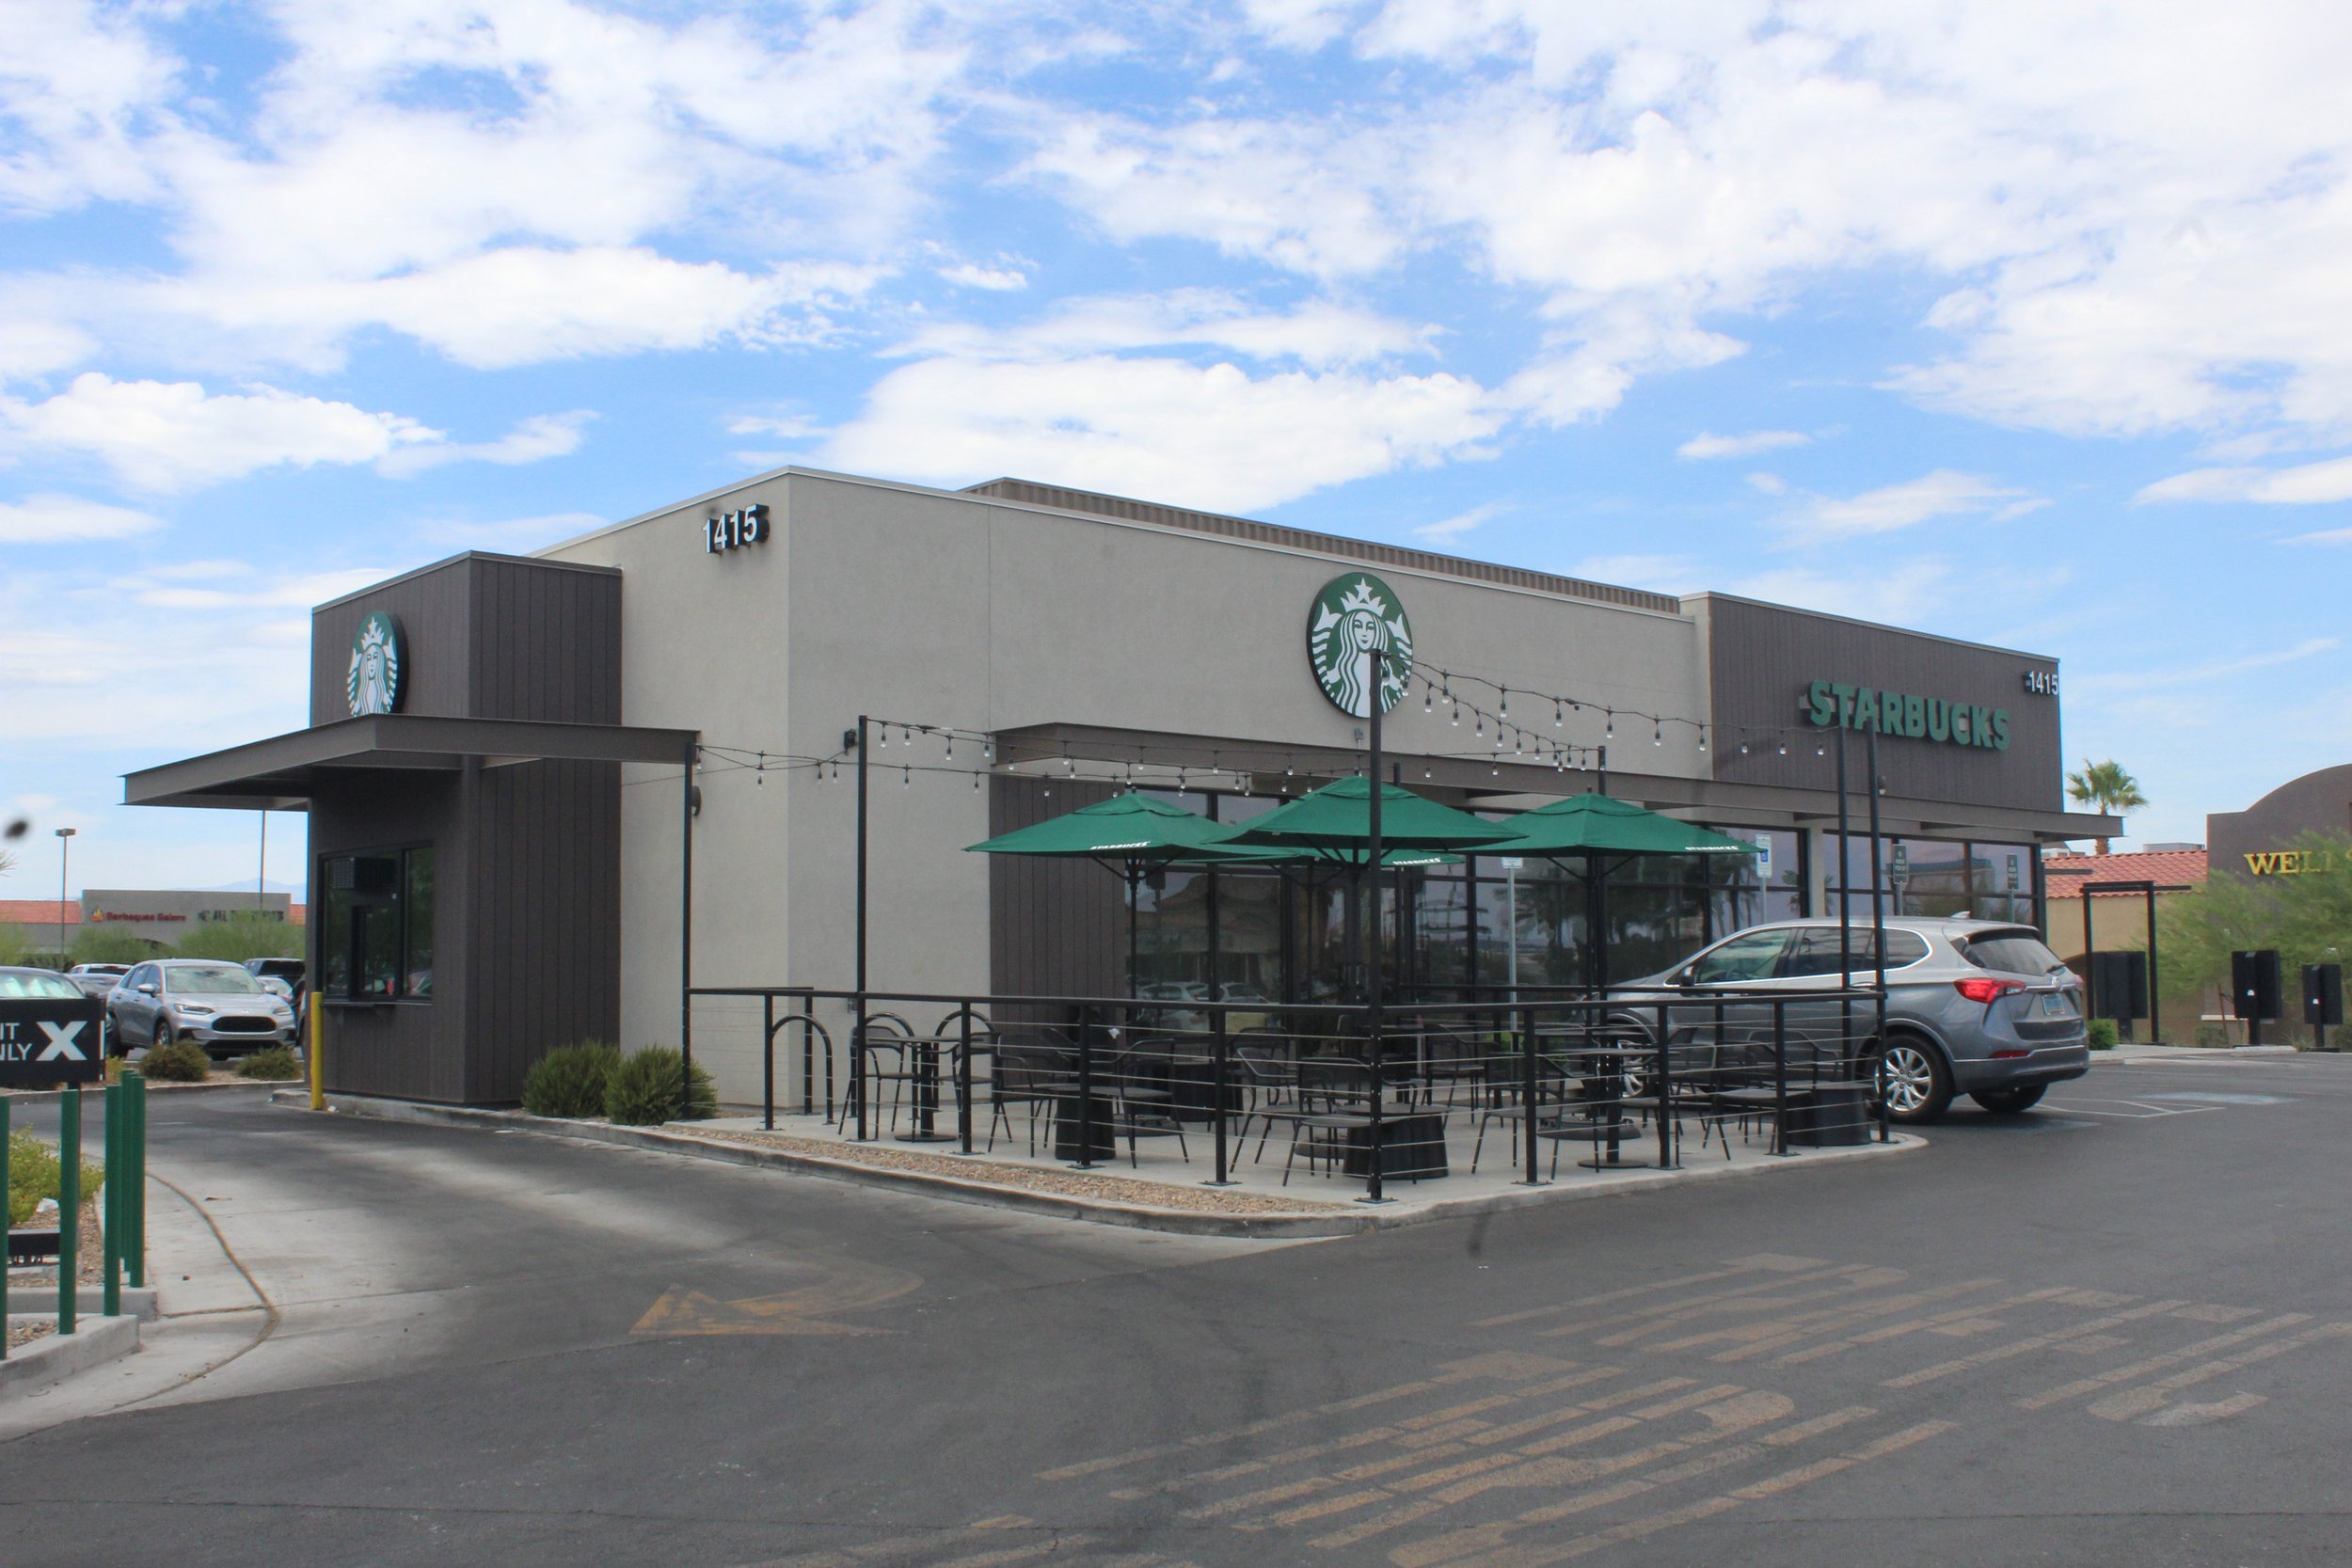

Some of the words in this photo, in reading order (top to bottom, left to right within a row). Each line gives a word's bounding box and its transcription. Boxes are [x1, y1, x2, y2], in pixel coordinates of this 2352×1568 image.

[702, 504, 760, 553] 1415
[2028, 671, 2058, 696] 1415
[1810, 679, 2010, 751] STARBUCKS
[2244, 850, 2352, 875] WELL
